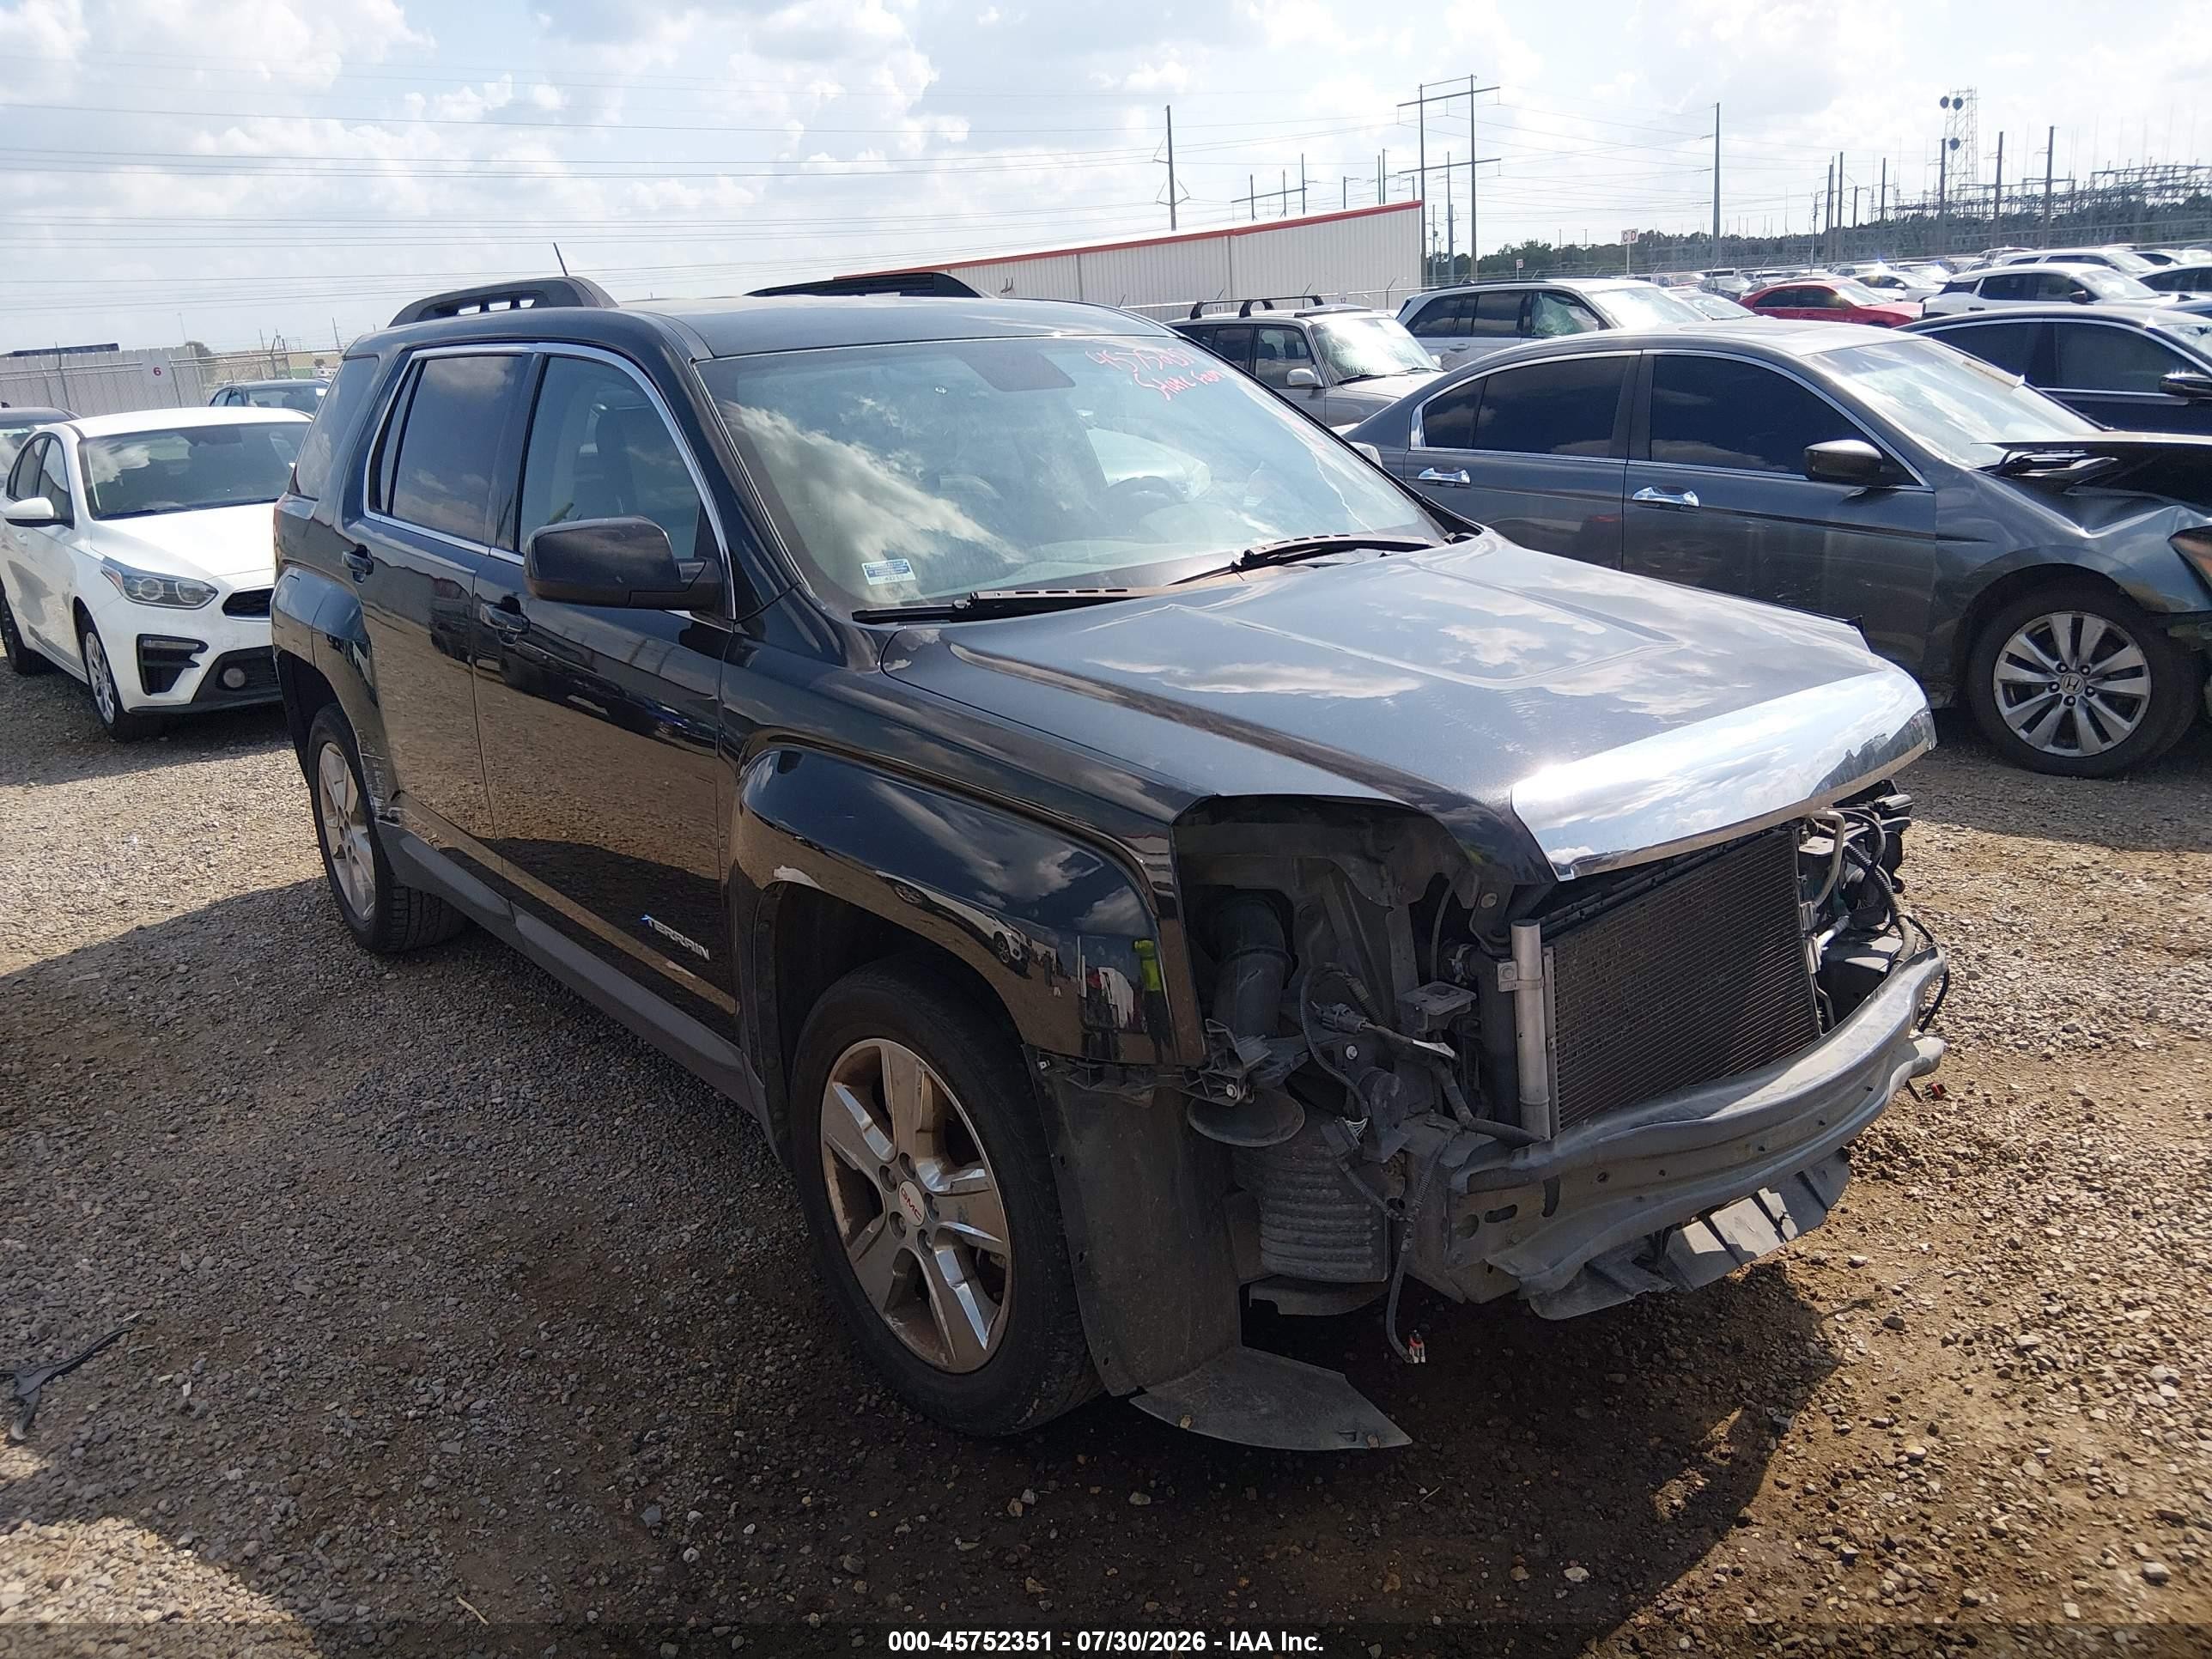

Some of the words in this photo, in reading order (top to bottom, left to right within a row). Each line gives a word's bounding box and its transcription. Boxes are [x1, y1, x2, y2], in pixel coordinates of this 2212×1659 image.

[153, 367, 162, 377] 6
[641, 914, 710, 961] TERRAIN
[901, 1188, 922, 1221] GMC
